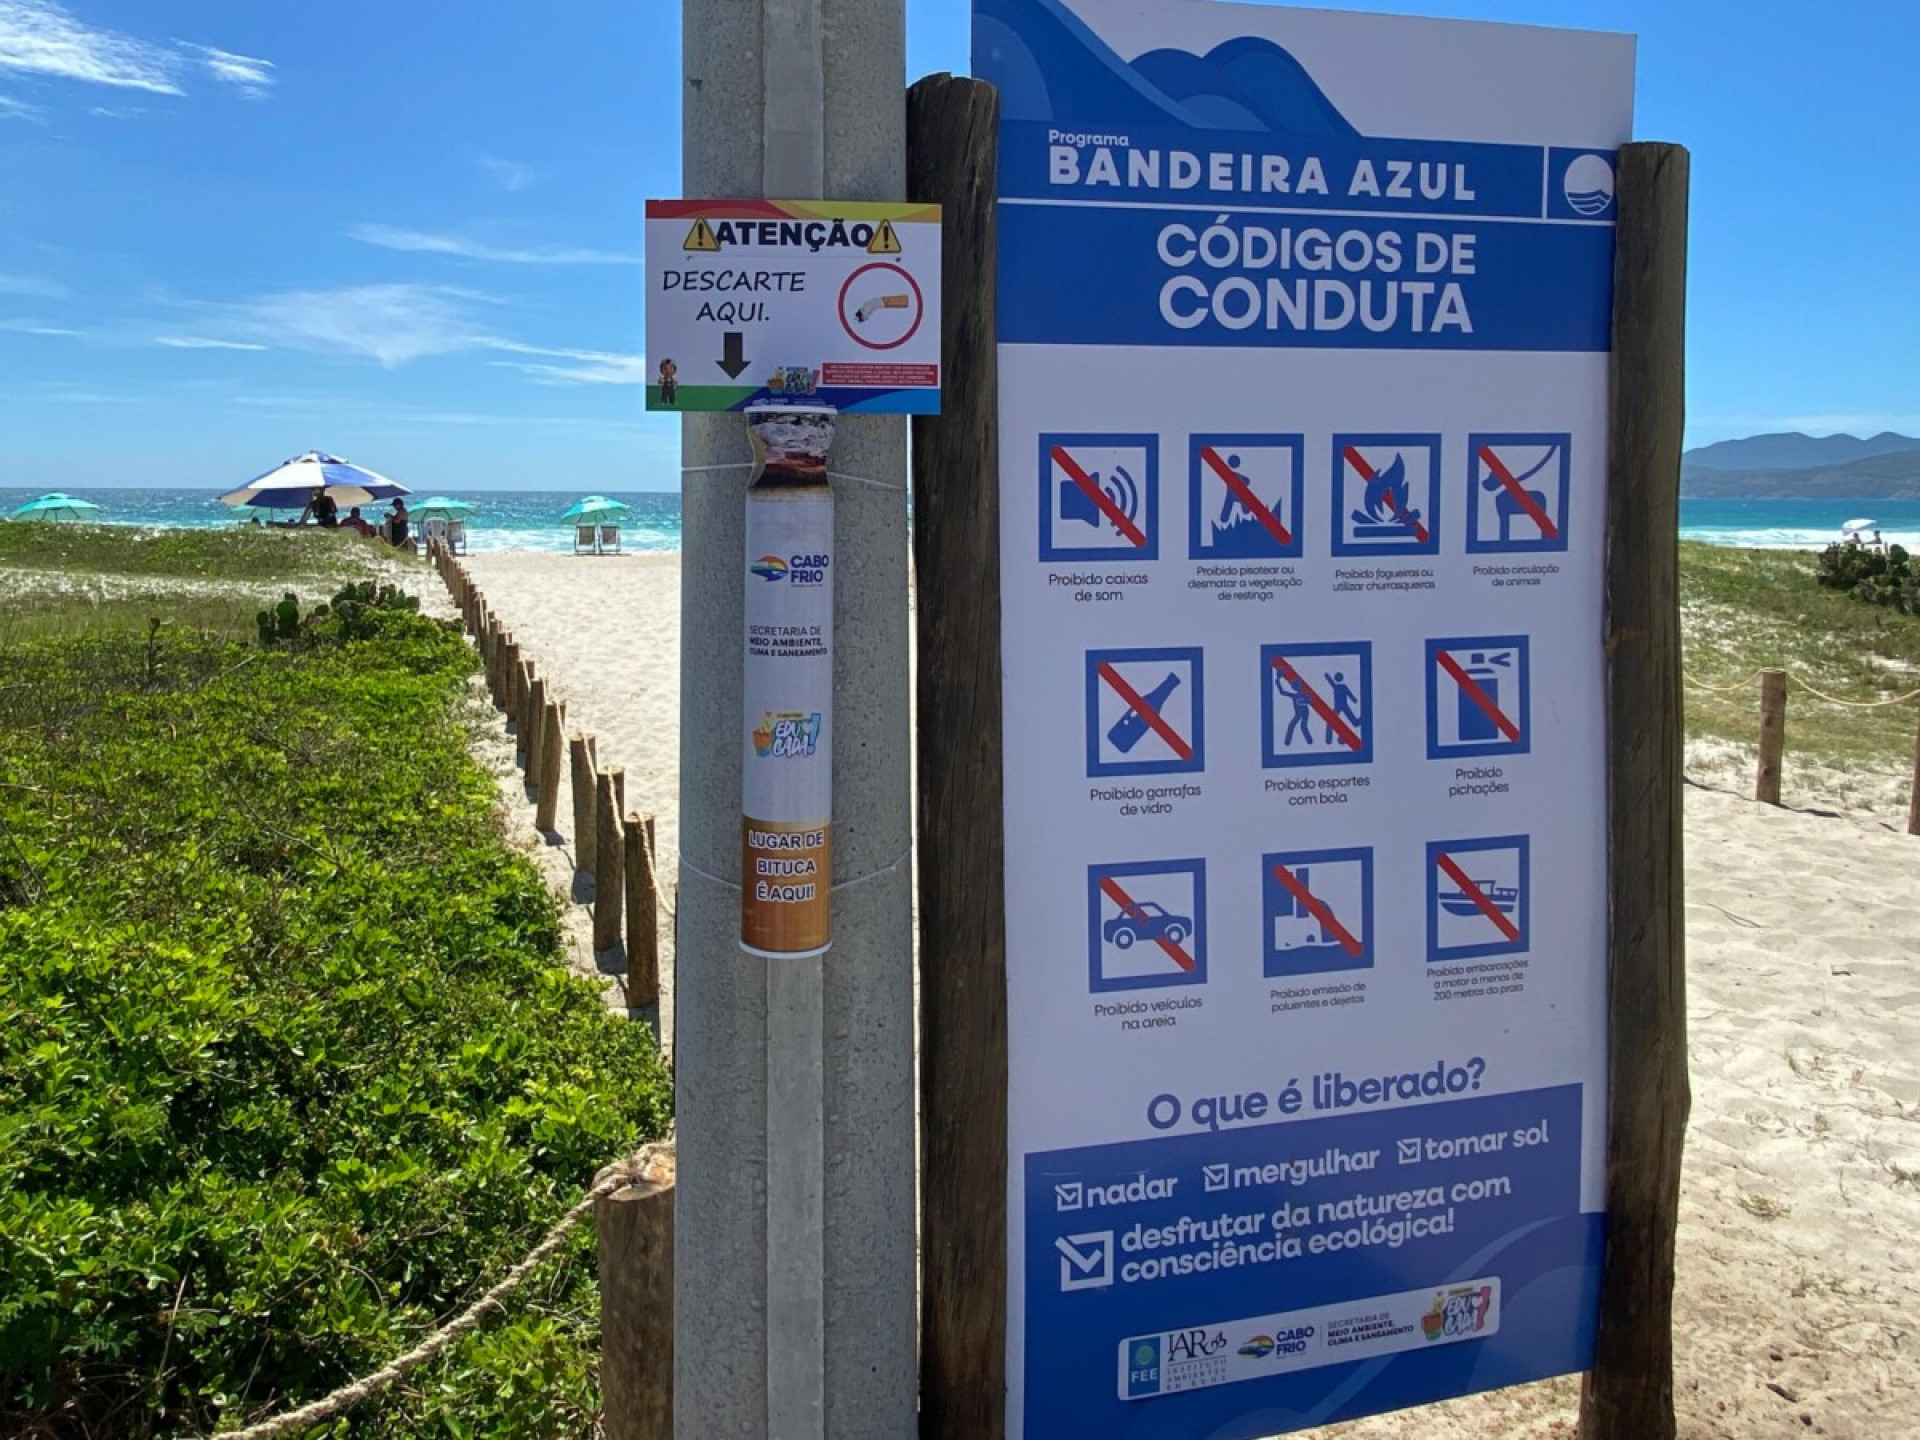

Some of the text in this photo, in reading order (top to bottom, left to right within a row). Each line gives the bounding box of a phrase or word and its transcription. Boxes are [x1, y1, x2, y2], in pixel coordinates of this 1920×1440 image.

[1048, 129, 1129, 148] Programa
[1048, 146, 1475, 201] BANDEIRA AZUL
[715, 218, 874, 251] ATENÇÃO
[1156, 214, 1476, 274] CÓDIGOS DE
[663, 270, 806, 292] DESCARTE
[1159, 274, 1473, 333] CONDUTA
[695, 301, 770, 325] AQUI.
[790, 554, 829, 568] CABO
[790, 570, 823, 583] FRIO
[1197, 565, 1295, 577] Proibido pisotear ou
[1335, 568, 1434, 580] Proibido fogueiras ou
[1473, 564, 1559, 576] Proibido circulação
[1049, 573, 1148, 586] Proibido caixas
[1188, 577, 1302, 590] desmatar a vegetação
[1333, 580, 1435, 592] utilizar churrasqueiras
[1492, 577, 1504, 586] de
[1075, 590, 1124, 601] de som
[1218, 590, 1274, 601] de restinga
[749, 625, 822, 636] SECRETARIA DE
[1455, 766, 1503, 780] Proibido
[1265, 775, 1370, 791] Proibido esportes
[1449, 781, 1509, 798] pichações
[1090, 785, 1202, 801] Proibido garrafas
[1288, 792, 1348, 806] com bola
[1120, 802, 1173, 816] de vidro
[749, 829, 824, 849] LUGAR DE
[757, 858, 816, 876] BITUCA
[1427, 960, 1528, 978] Proibido embarcações
[1433, 981, 1441, 989] a
[1442, 978, 1469, 987] motor
[1480, 974, 1510, 983] menos
[1270, 982, 1366, 1000] Proibido emissão de
[1434, 990, 1451, 1000] 200
[1453, 987, 1484, 998] metros
[1094, 996, 1203, 1017] Proibido veículos
[1271, 999, 1320, 1014] poluentes
[1330, 994, 1365, 1009] dejetos
[1122, 1015, 1176, 1031] na areia
[1147, 1056, 1486, 1132] O que é liberado?
[1426, 1120, 1549, 1161] tomar sol
[1234, 1147, 1381, 1188] mergulhar
[1086, 1173, 1178, 1208] nadar
[1121, 1176, 1511, 1253] desfrutar da natureza com
[1121, 1210, 1455, 1283] consciência ecológica!
[1328, 1313, 1377, 1329] SECRETARIA
[1276, 1326, 1314, 1342] CABO
[1276, 1341, 1306, 1356] FRIO
[1131, 1367, 1158, 1384] FEE
